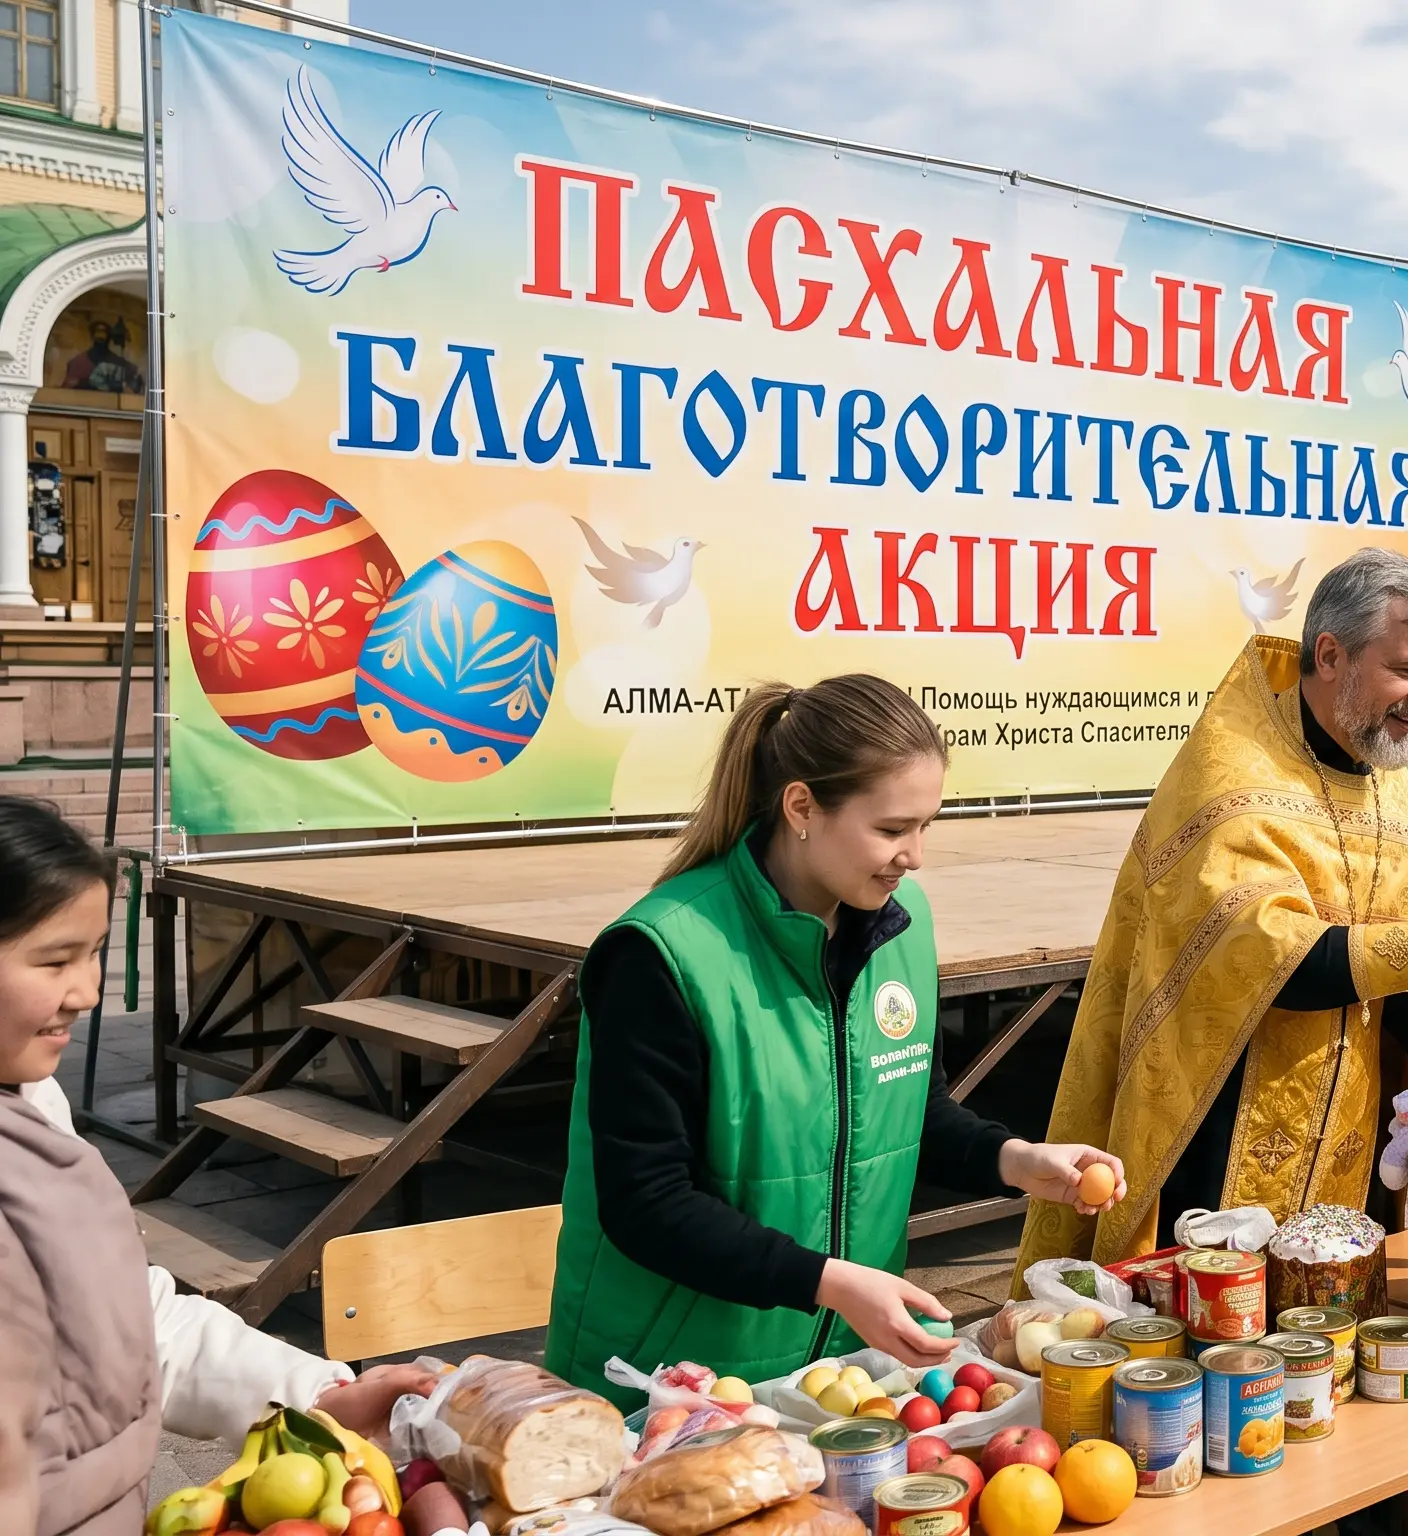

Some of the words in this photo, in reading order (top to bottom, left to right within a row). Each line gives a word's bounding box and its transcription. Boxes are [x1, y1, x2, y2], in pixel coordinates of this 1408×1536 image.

[520, 161, 1349, 405] ПАСХАЛЬНАЯ
[794, 526, 1157, 657] АКЦИЯ
[603, 687, 750, 714] АЛМА-АТ
[921, 686, 1018, 713] Помощь
[1025, 691, 1181, 715] нуждающимся
[1187, 691, 1198, 707] и
[937, 723, 987, 751] рам
[995, 722, 1073, 751] Христа
[1080, 720, 1190, 743] Спасителя
